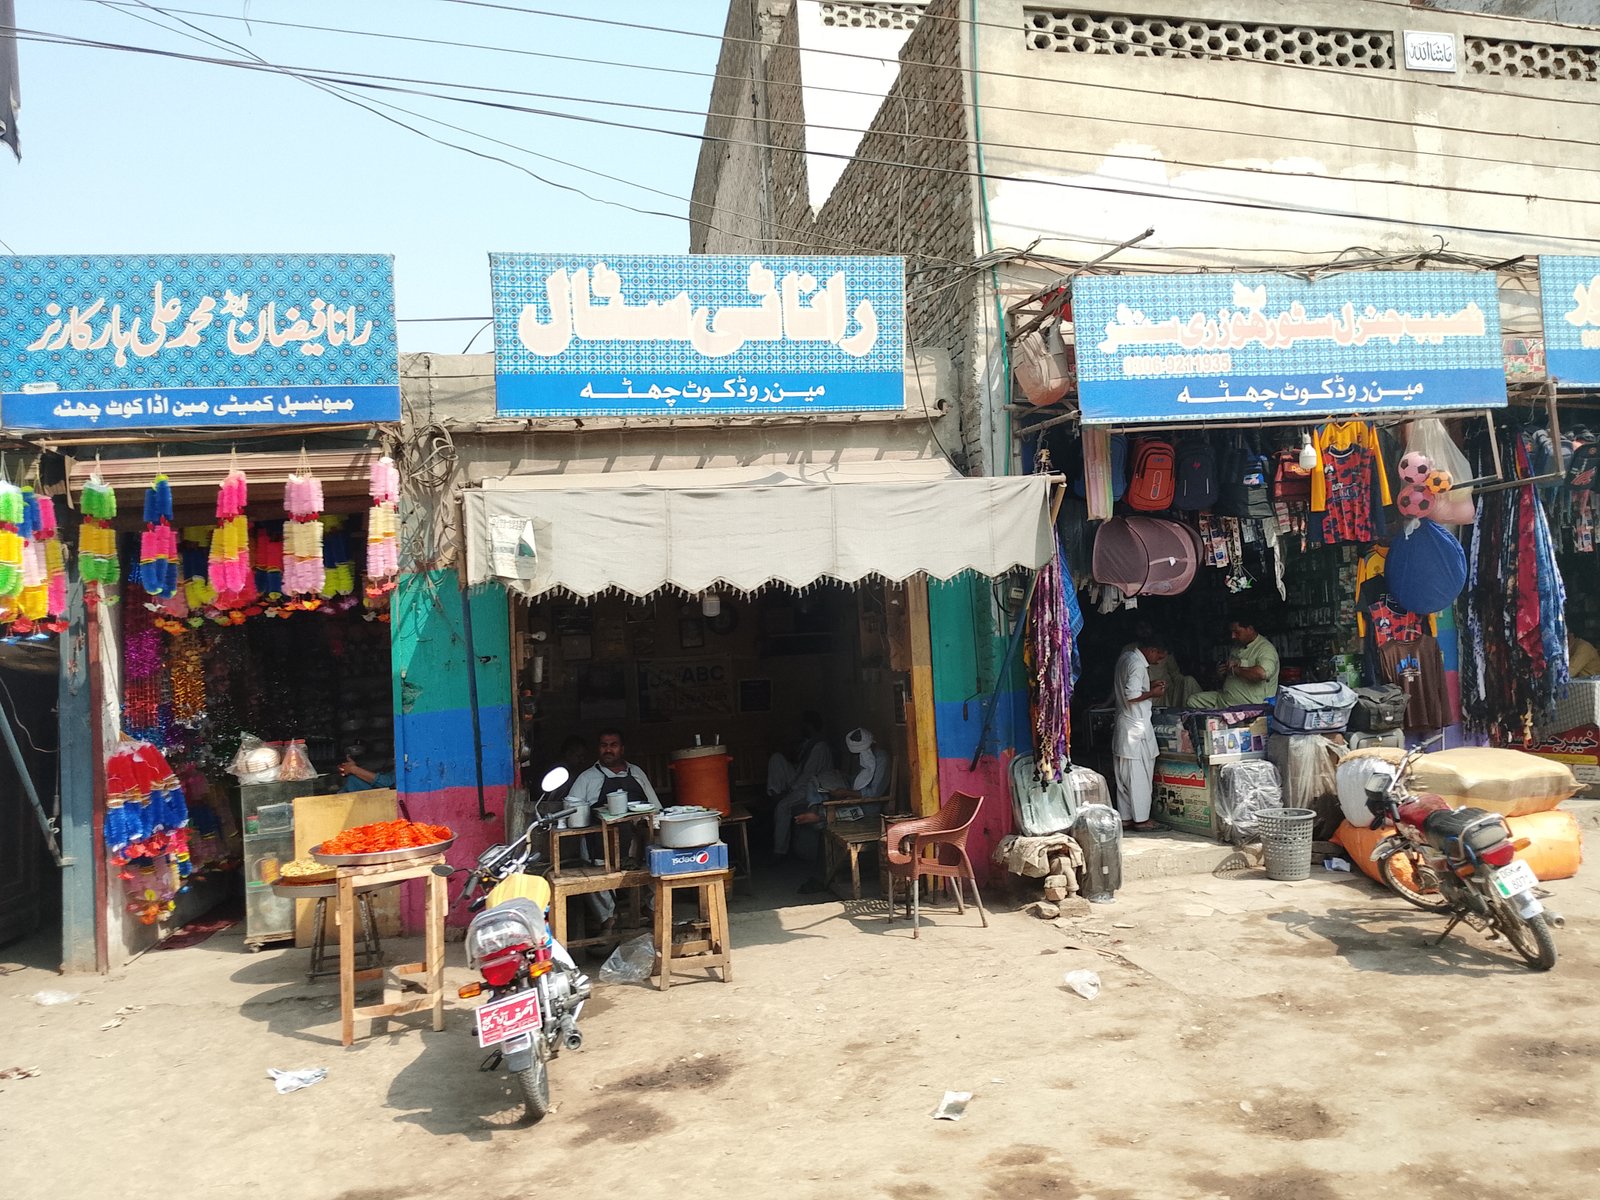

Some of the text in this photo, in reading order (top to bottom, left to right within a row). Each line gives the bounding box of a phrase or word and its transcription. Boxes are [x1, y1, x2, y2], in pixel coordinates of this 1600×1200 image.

[130, 280, 182, 357] علی
[164, 296, 216, 348] محمد
[227, 297, 327, 356] فیضان
[327, 303, 372, 346] رانا
[518, 260, 878, 358] رانا ٹی سٹال
[1336, 301, 1405, 346] جنرل
[53, 393, 355, 423] میونسپل کمیٹی مین اڈا کوٹ چھٹہ
[579, 375, 826, 407] مین روڈ کوٹ چھٹہ
[1177, 374, 1424, 411] مین روڈ کوٹ چھٹہ
[680, 665, 725, 683] ABC
